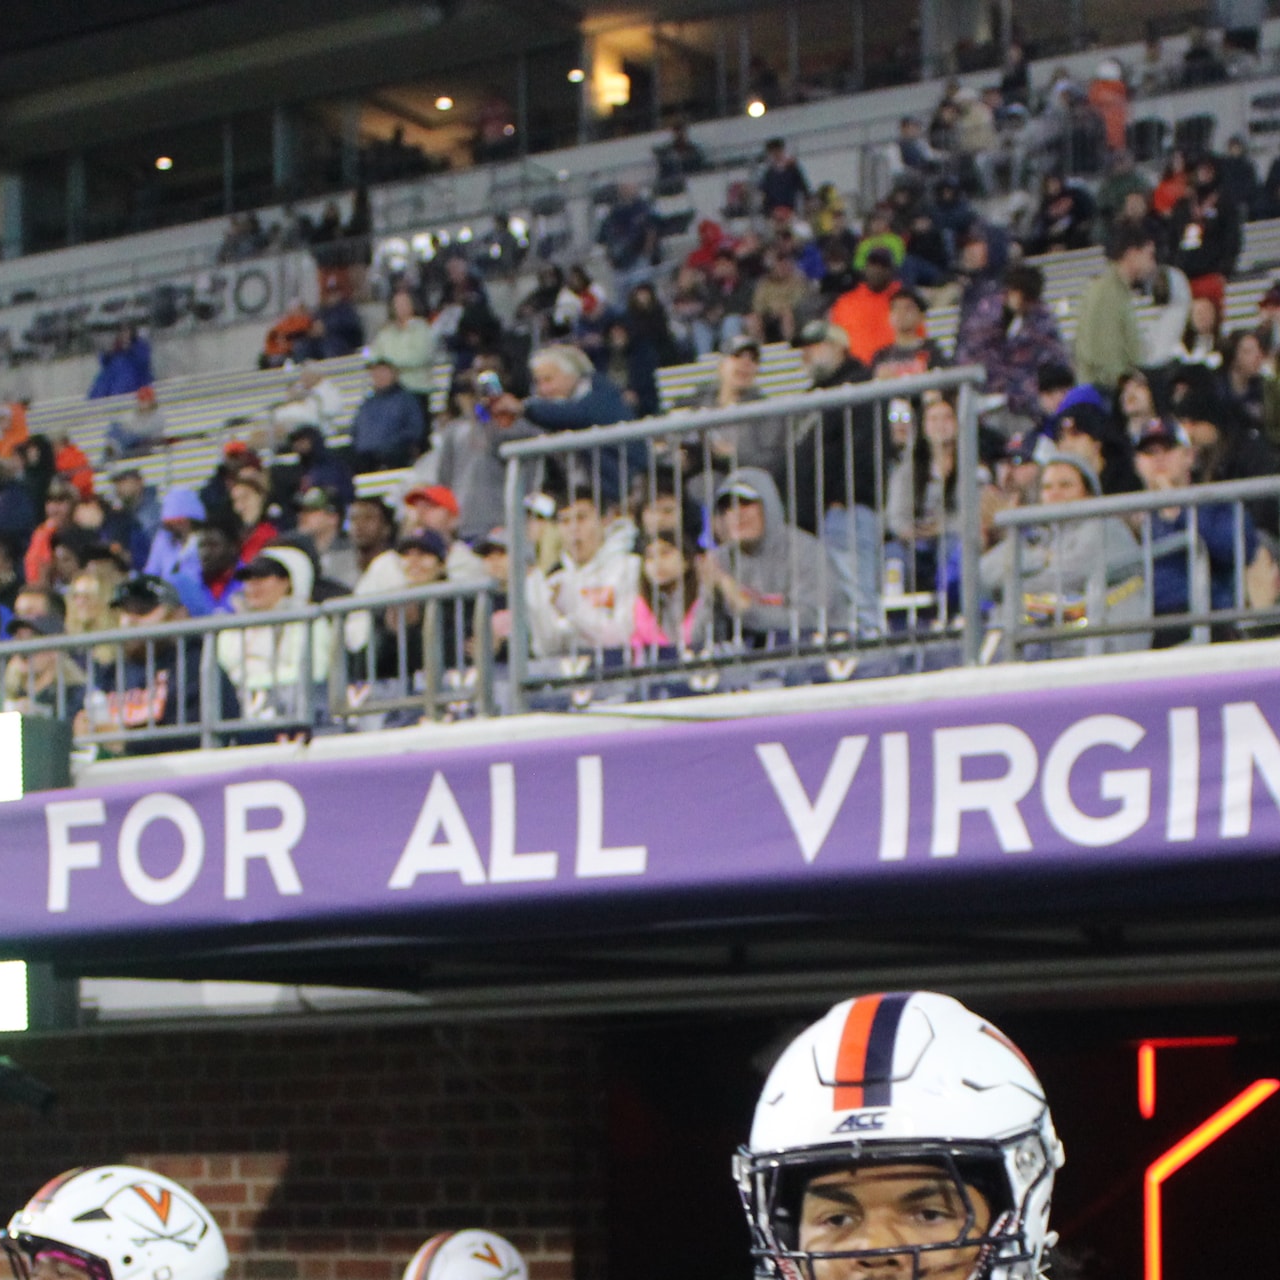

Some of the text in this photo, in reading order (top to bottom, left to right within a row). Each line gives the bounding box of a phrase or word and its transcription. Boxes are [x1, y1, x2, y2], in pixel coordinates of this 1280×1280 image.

[45, 780, 304, 913] FOR
[389, 755, 648, 889] ALL
[831, 1111, 888, 1134] ACC
